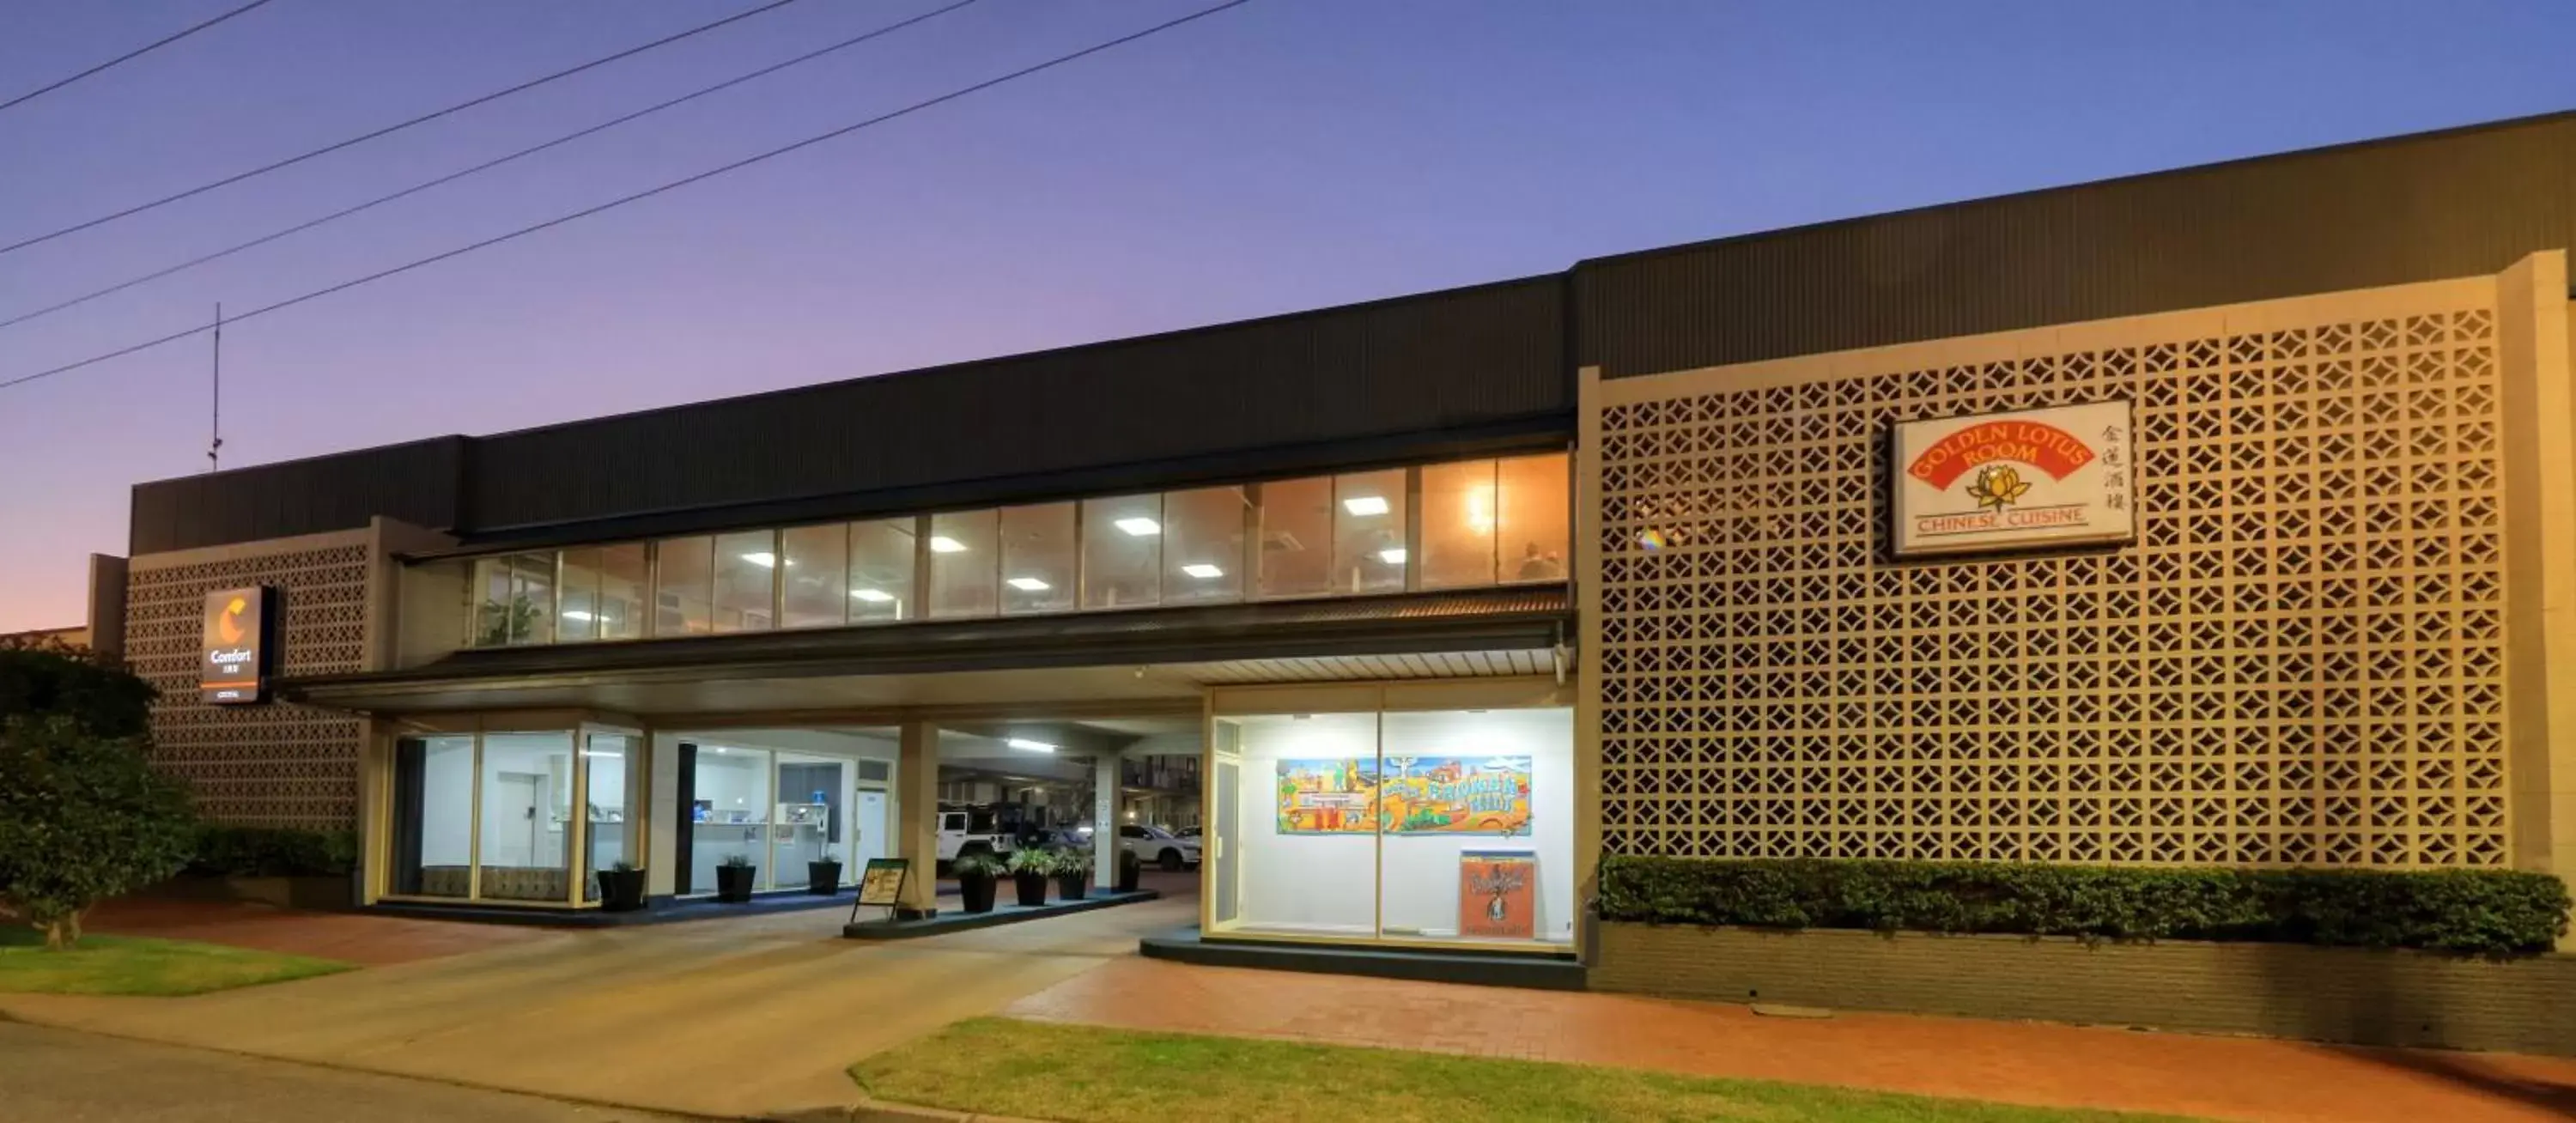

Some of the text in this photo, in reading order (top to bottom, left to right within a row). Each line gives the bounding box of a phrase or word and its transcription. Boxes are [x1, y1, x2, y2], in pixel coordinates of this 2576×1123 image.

[1914, 425, 2086, 477] GOLDEN LOTUS
[1962, 441, 2038, 468] ROOM
[1917, 507, 2087, 532] CHINESE CUISINE
[210, 648, 251, 664] Comfort
